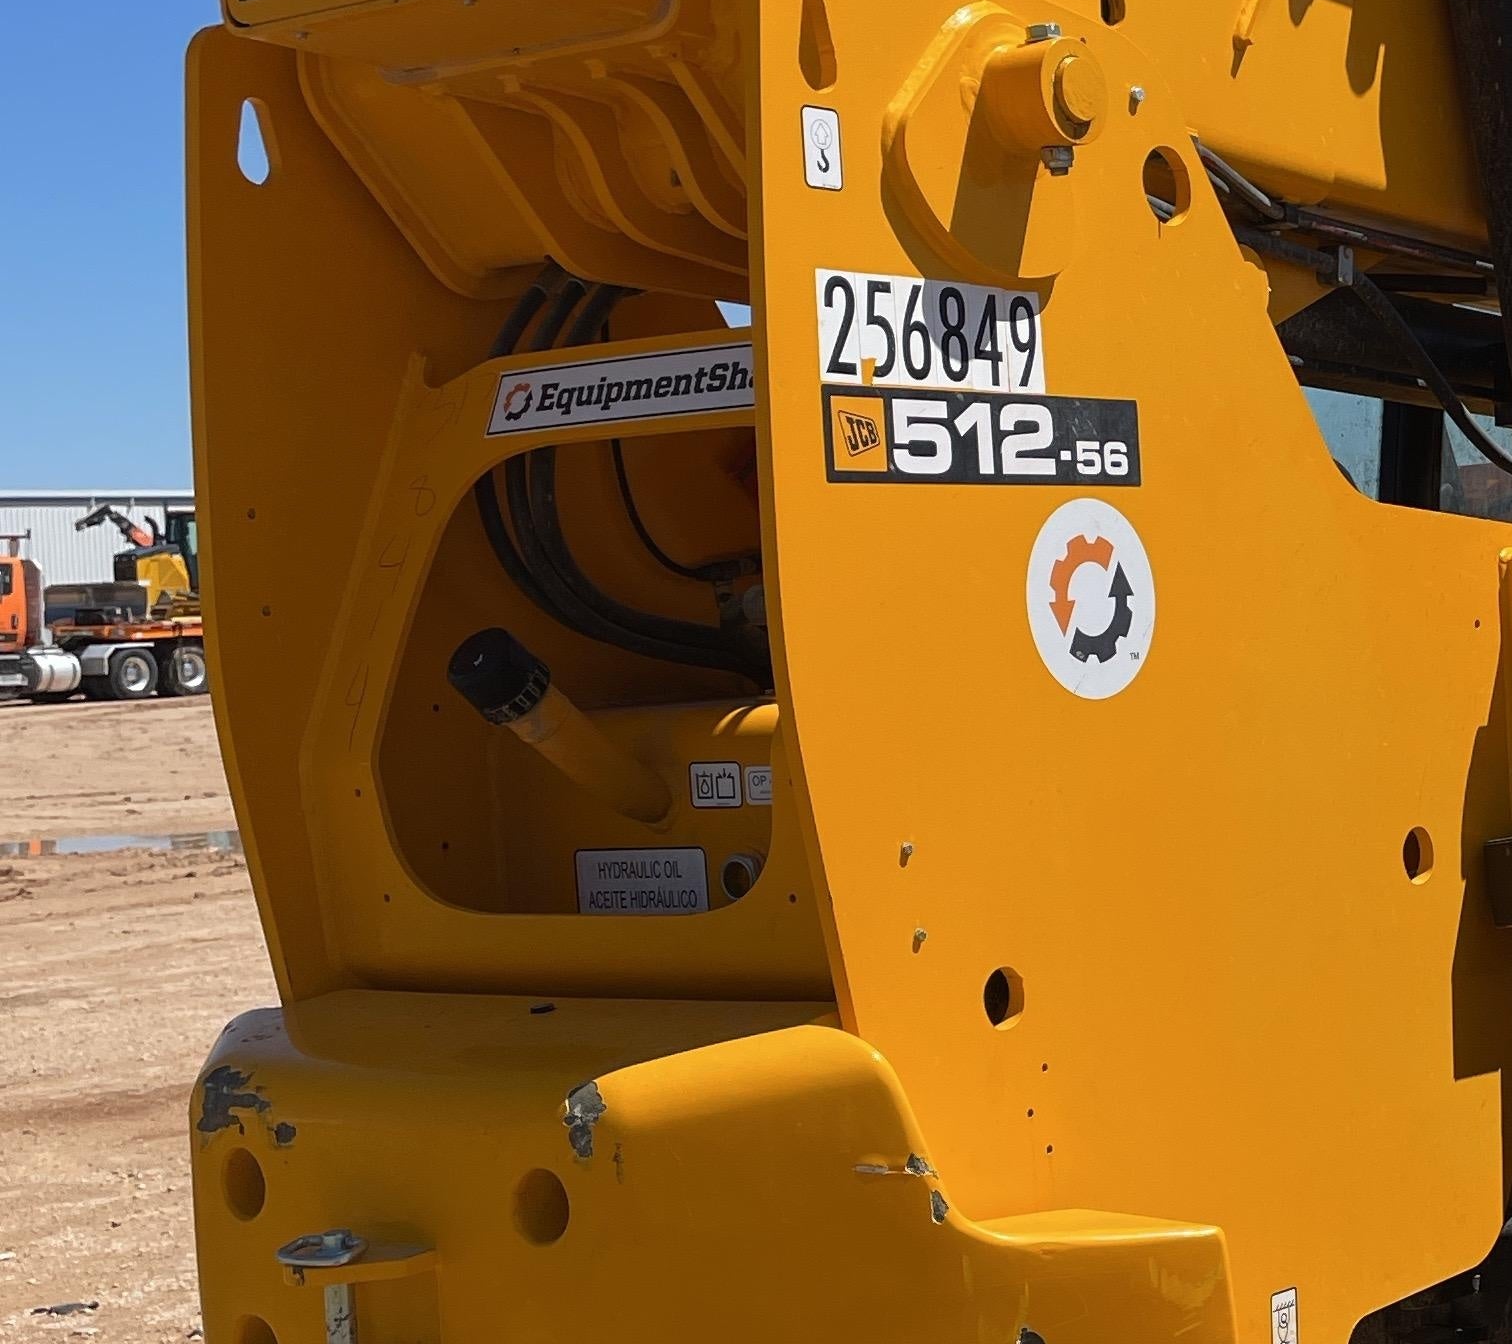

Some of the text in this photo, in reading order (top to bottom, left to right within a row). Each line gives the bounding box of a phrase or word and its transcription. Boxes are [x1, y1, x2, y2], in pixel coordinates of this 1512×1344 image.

[823, 275, 1037, 387] 256849
[845, 414, 879, 453] JCB
[597, 860, 683, 879] HYDRAULIC OIL
[588, 890, 628, 909] ACEITE
